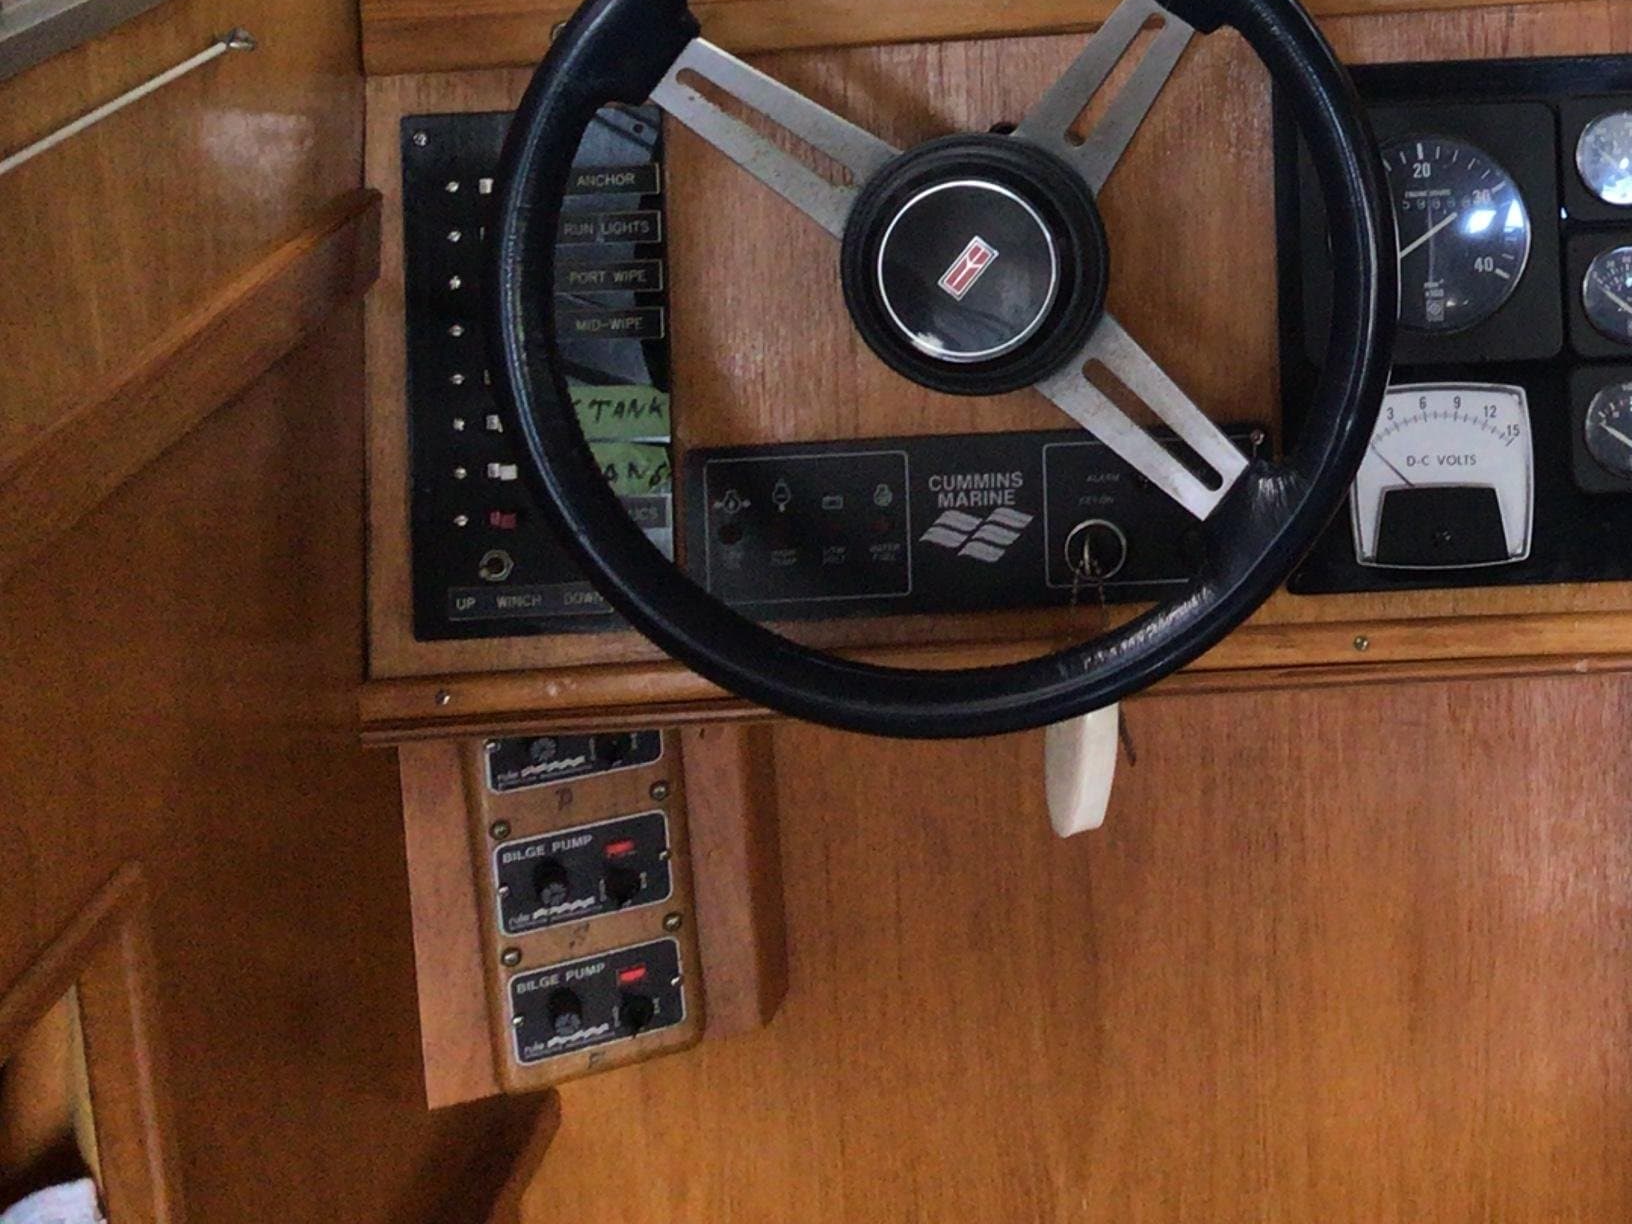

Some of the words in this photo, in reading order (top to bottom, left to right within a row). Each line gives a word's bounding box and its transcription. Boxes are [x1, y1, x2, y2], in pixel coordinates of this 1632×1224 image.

[1412, 162, 1432, 178] 20
[576, 172, 636, 187] ANCHOR
[563, 222, 594, 235] RUN
[602, 220, 650, 235] LIGHTS
[1473, 256, 1494, 273] 40
[568, 270, 605, 283] PORT
[613, 269, 648, 283] WIPE
[1386, 407, 1394, 421] 3
[1418, 396, 1427, 410] 6
[1453, 396, 1461, 410] 9
[1483, 405, 1497, 419] 12
[1507, 424, 1521, 438] 15
[1437, 454, 1477, 467] VOLTS
[928, 472, 1024, 492] CUMMINS
[936, 489, 1018, 509] MARINE
[455, 596, 477, 611] UP
[496, 594, 543, 609] WINCH
[502, 843, 547, 864] BILGE
[551, 834, 593, 853] PUMP
[516, 973, 560, 994] BILGE
[565, 962, 606, 982] PUMP
